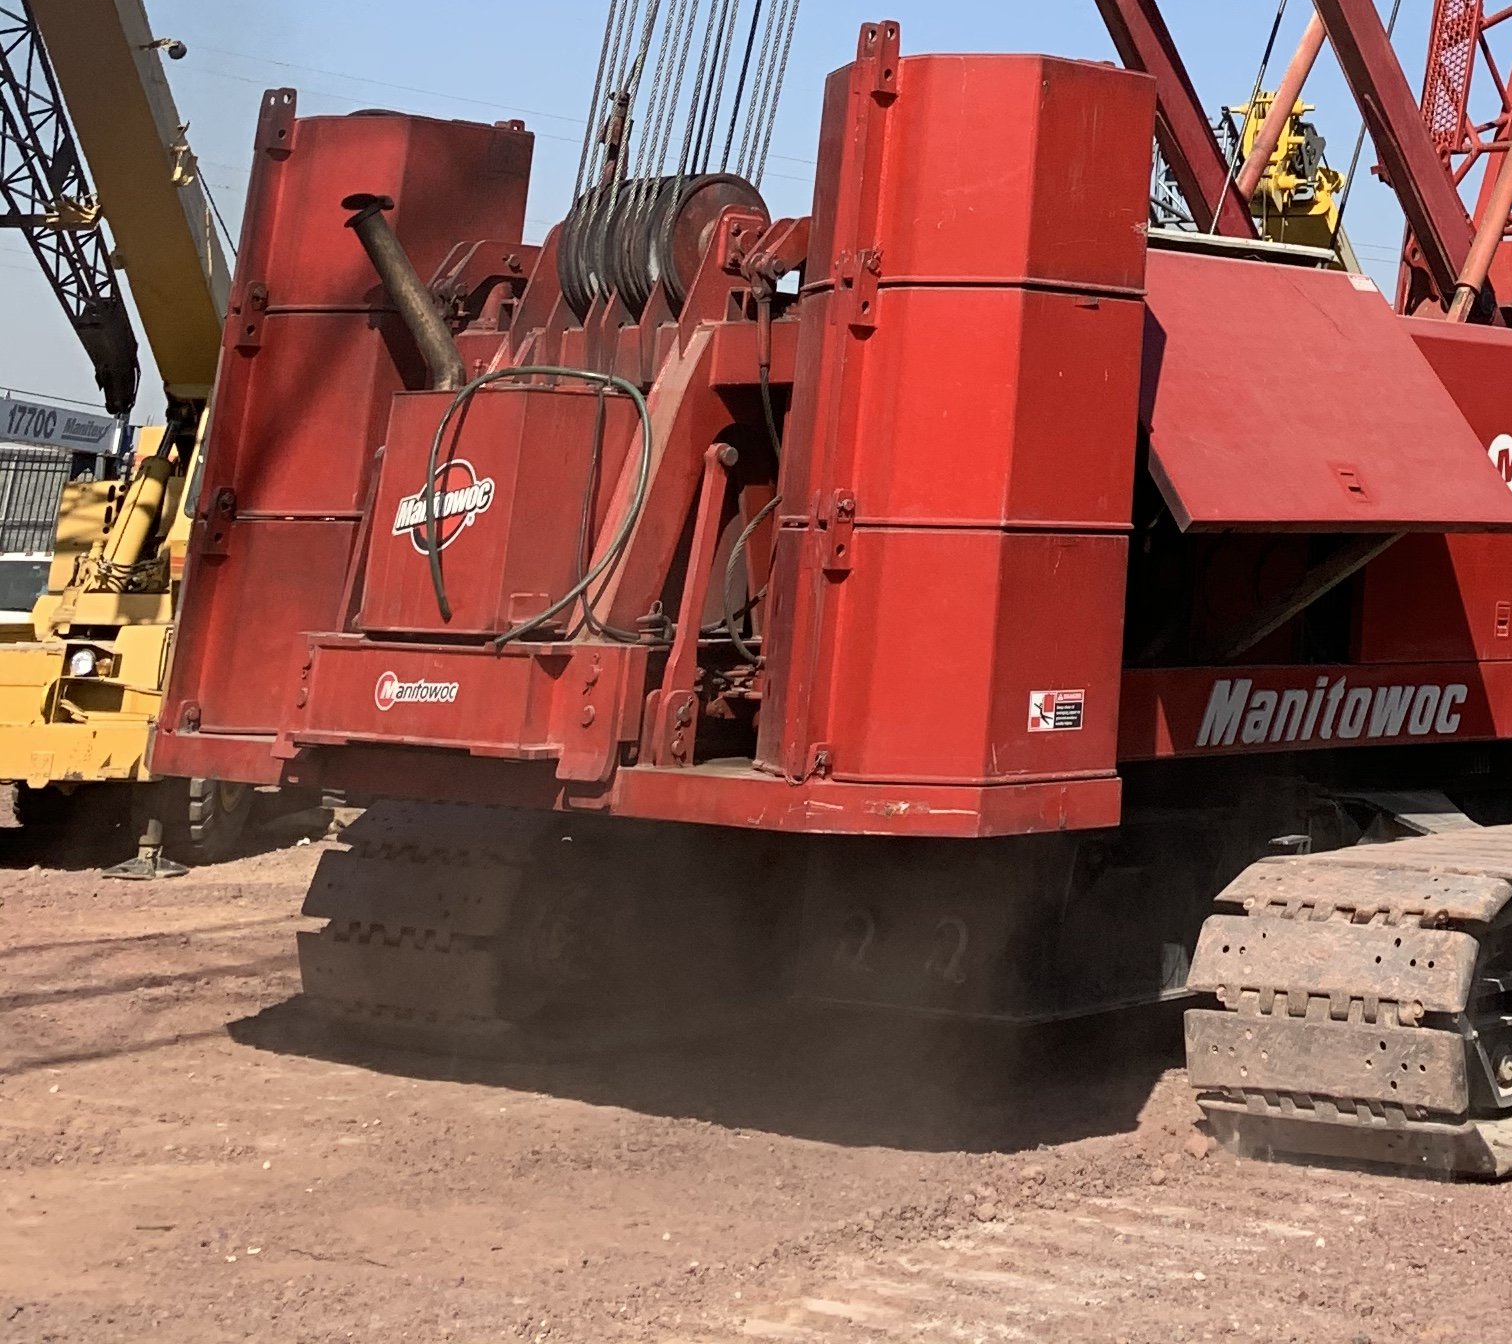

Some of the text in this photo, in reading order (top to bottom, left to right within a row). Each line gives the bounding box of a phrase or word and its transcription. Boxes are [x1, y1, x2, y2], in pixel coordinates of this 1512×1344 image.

[7, 403, 58, 439] 1770C
[62, 416, 104, 438] Manitex
[379, 677, 458, 702] Manitowoc
[1195, 675, 1469, 747] Manitowoc
